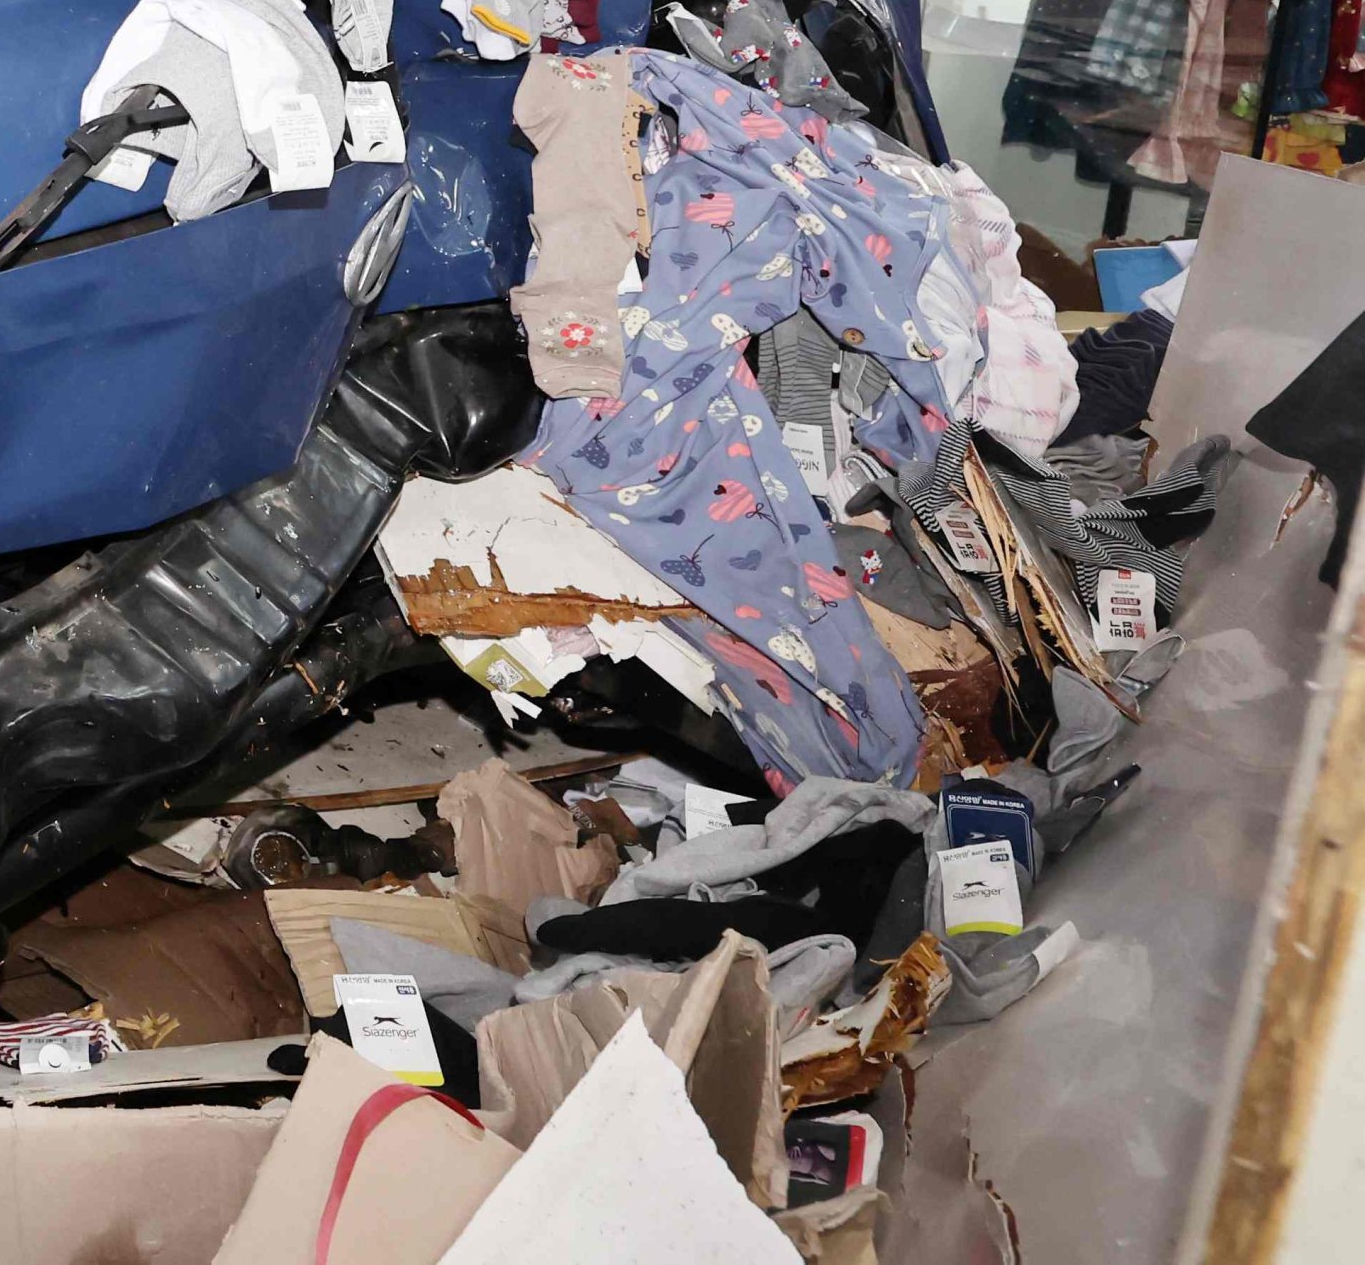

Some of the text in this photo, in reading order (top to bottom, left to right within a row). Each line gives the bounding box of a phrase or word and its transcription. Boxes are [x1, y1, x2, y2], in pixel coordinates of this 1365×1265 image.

[1005, 800, 1026, 810] KOREA
[952, 887, 1006, 902] Slazenger
[362, 1026, 419, 1040] Slazenger
